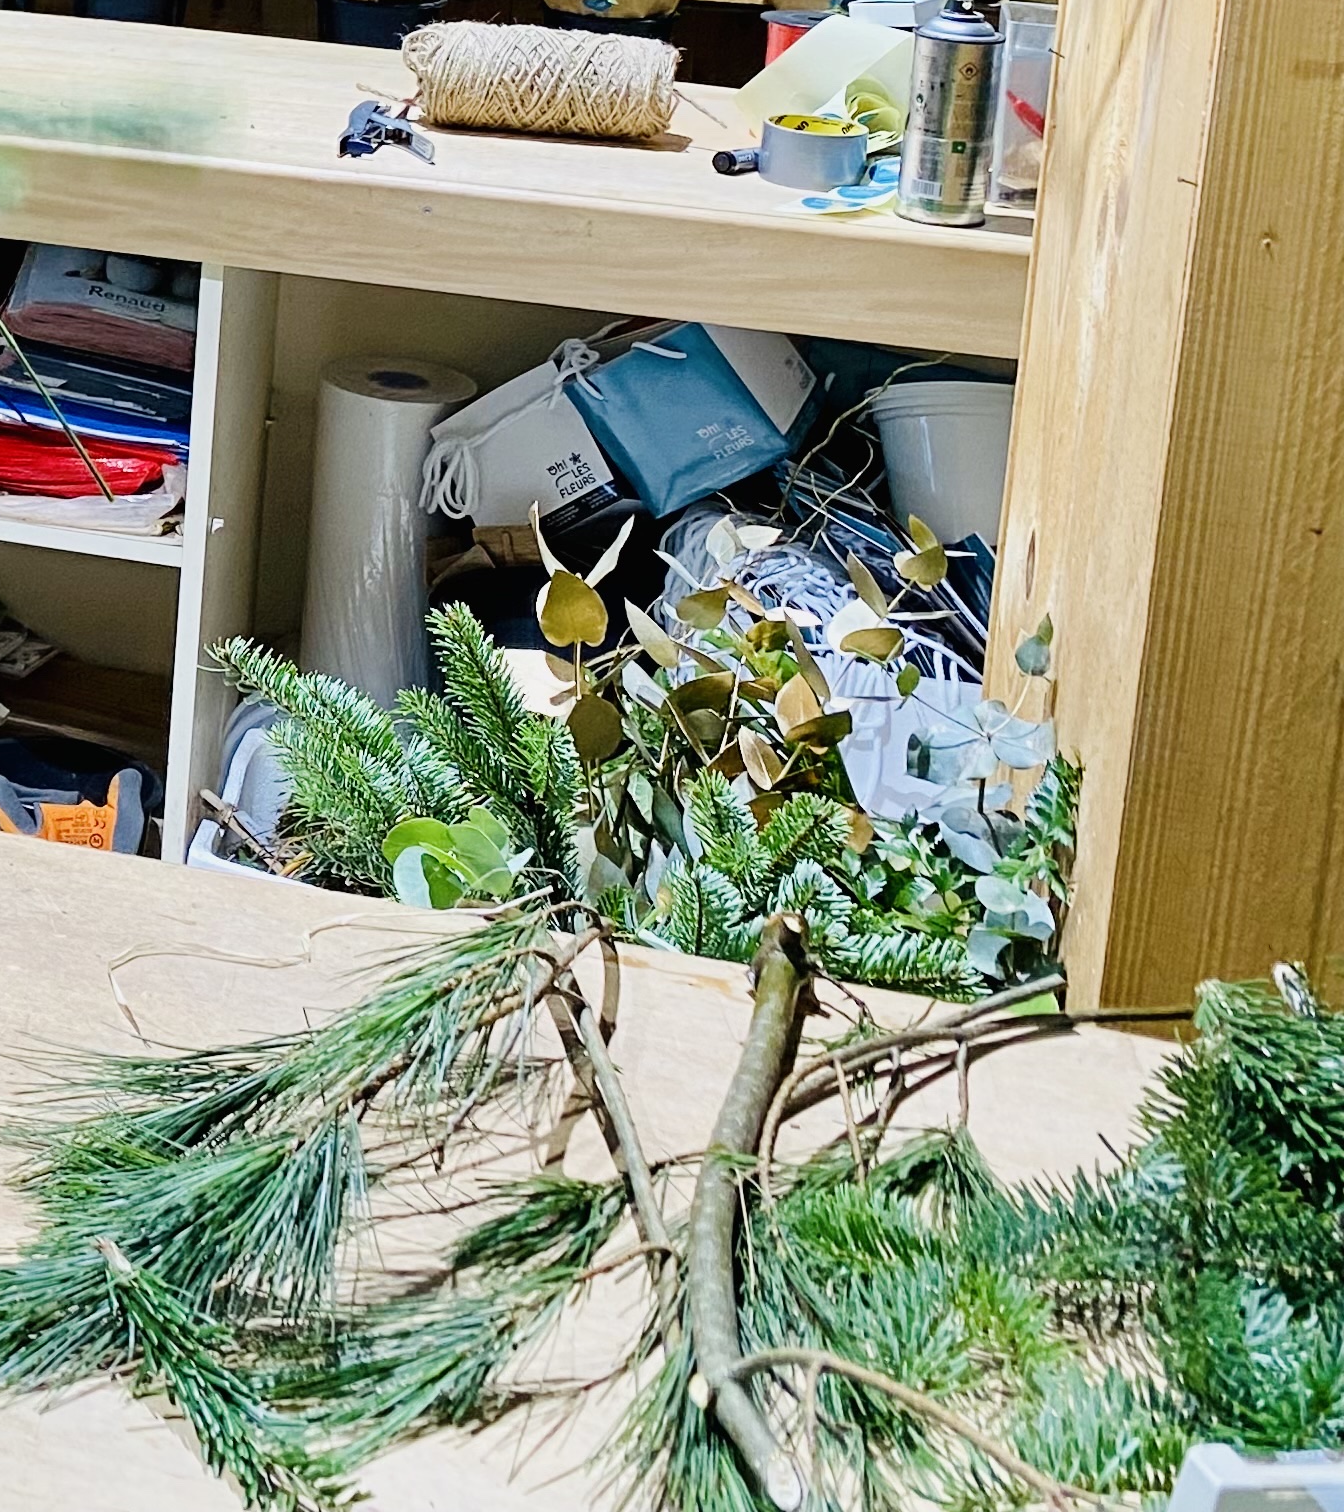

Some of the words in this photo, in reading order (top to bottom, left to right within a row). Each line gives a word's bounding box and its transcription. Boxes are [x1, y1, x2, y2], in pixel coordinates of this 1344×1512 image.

[88, 284, 166, 313] Renaud
[725, 425, 747, 440] LES
[713, 435, 755, 460] FLEURS
[546, 459, 568, 476] Oh!
[571, 462, 591, 478] LES
[559, 473, 596, 498] FLEURS
